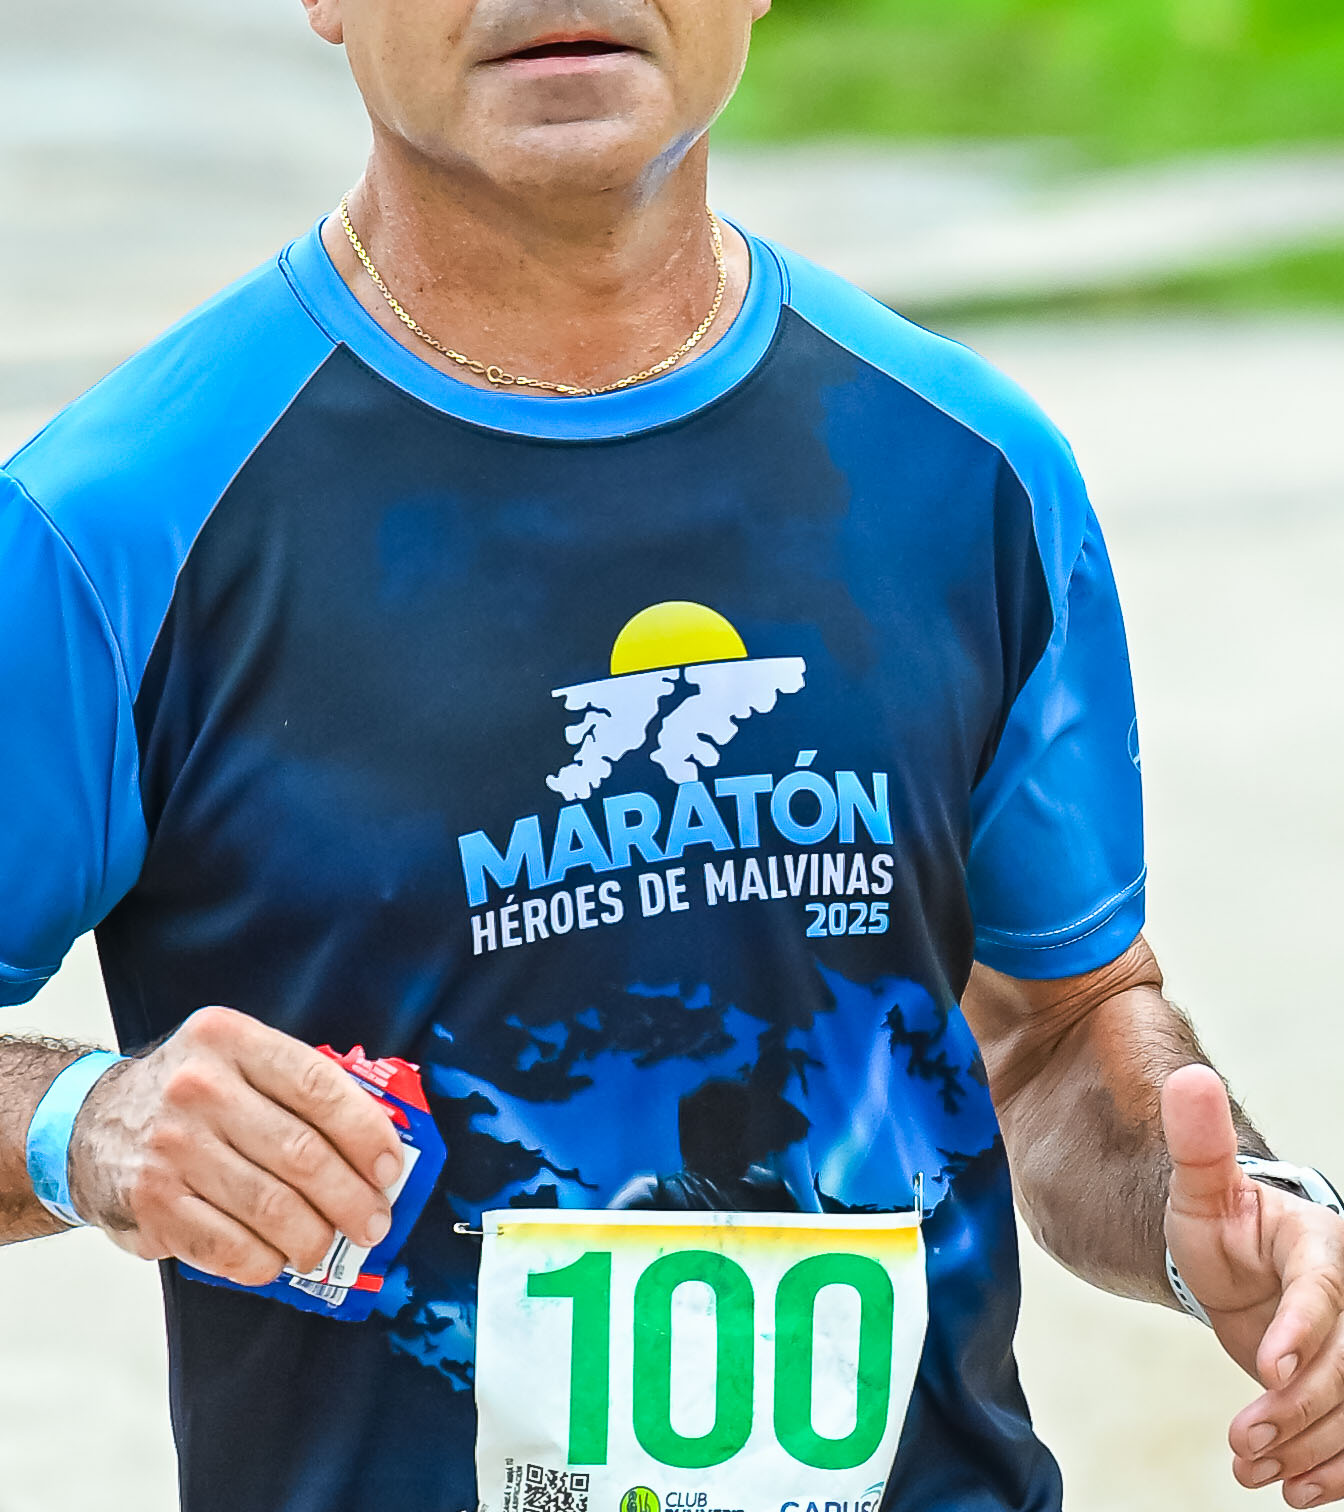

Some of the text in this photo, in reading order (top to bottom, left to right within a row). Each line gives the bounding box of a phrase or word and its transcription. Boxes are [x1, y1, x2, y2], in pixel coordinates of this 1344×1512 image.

[457, 749, 895, 908] MARATÓN
[469, 852, 895, 956] HÉROES DE MALVINAS
[804, 902, 891, 938] 2025
[526, 1249, 895, 1471] 100
[665, 1491, 708, 1508] CLUB
